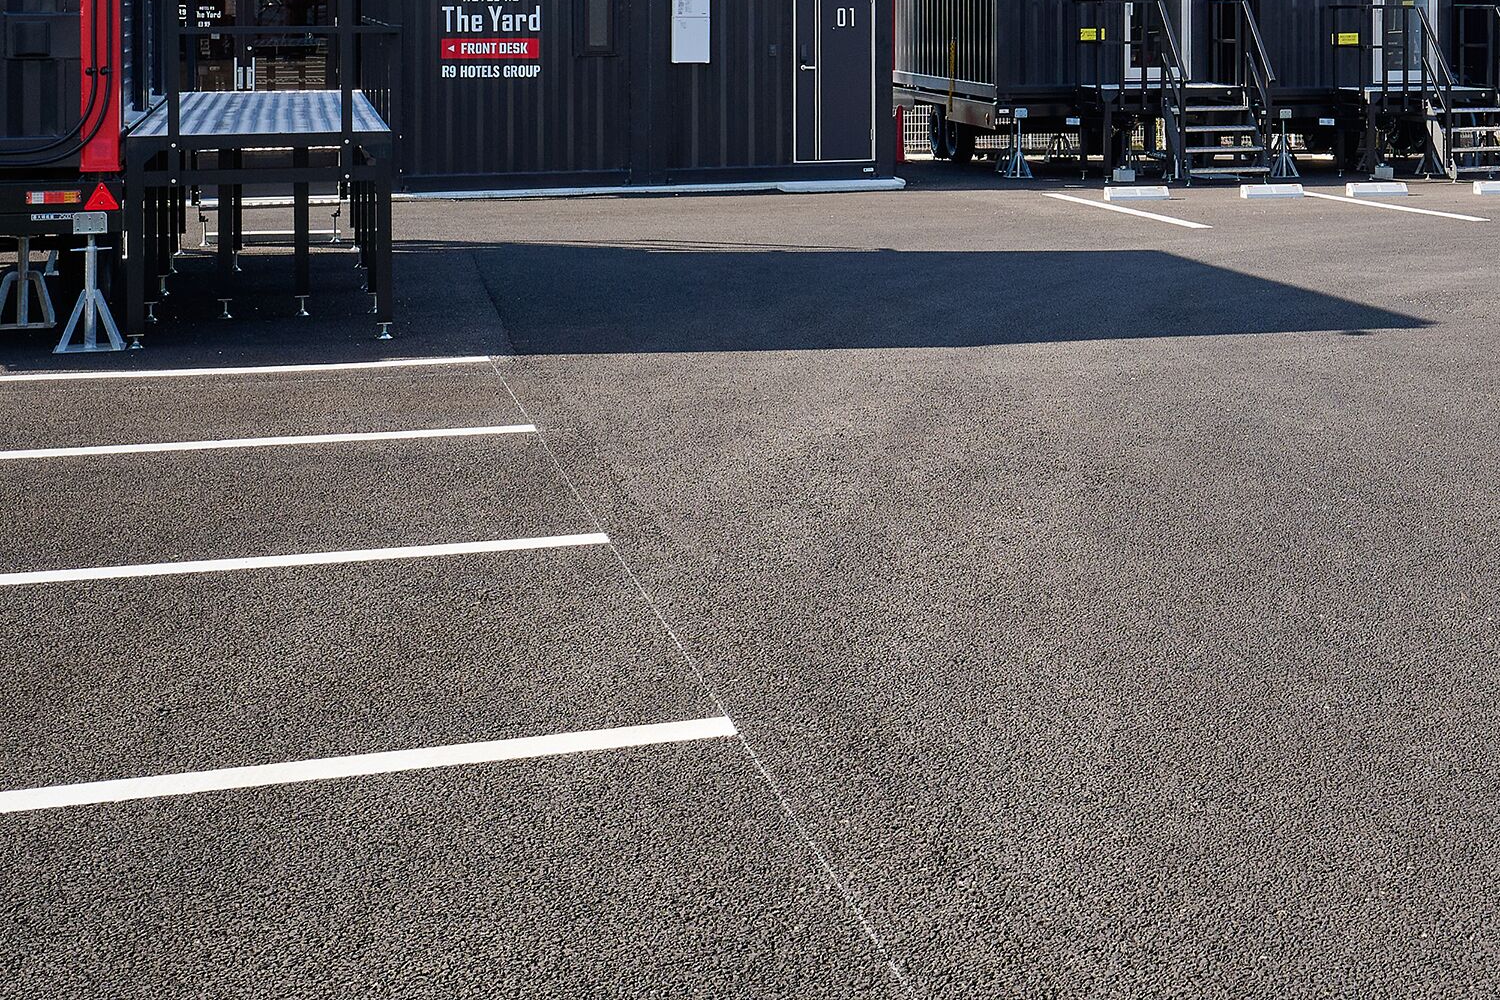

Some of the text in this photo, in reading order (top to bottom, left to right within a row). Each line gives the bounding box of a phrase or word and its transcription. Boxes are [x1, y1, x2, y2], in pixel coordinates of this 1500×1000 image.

[441, 5, 541, 32] The Yard
[837, 7, 855, 27] 01
[460, 42, 528, 54] FRONT DESK
[441, 65, 541, 78] R9 HOTELS GROUP
